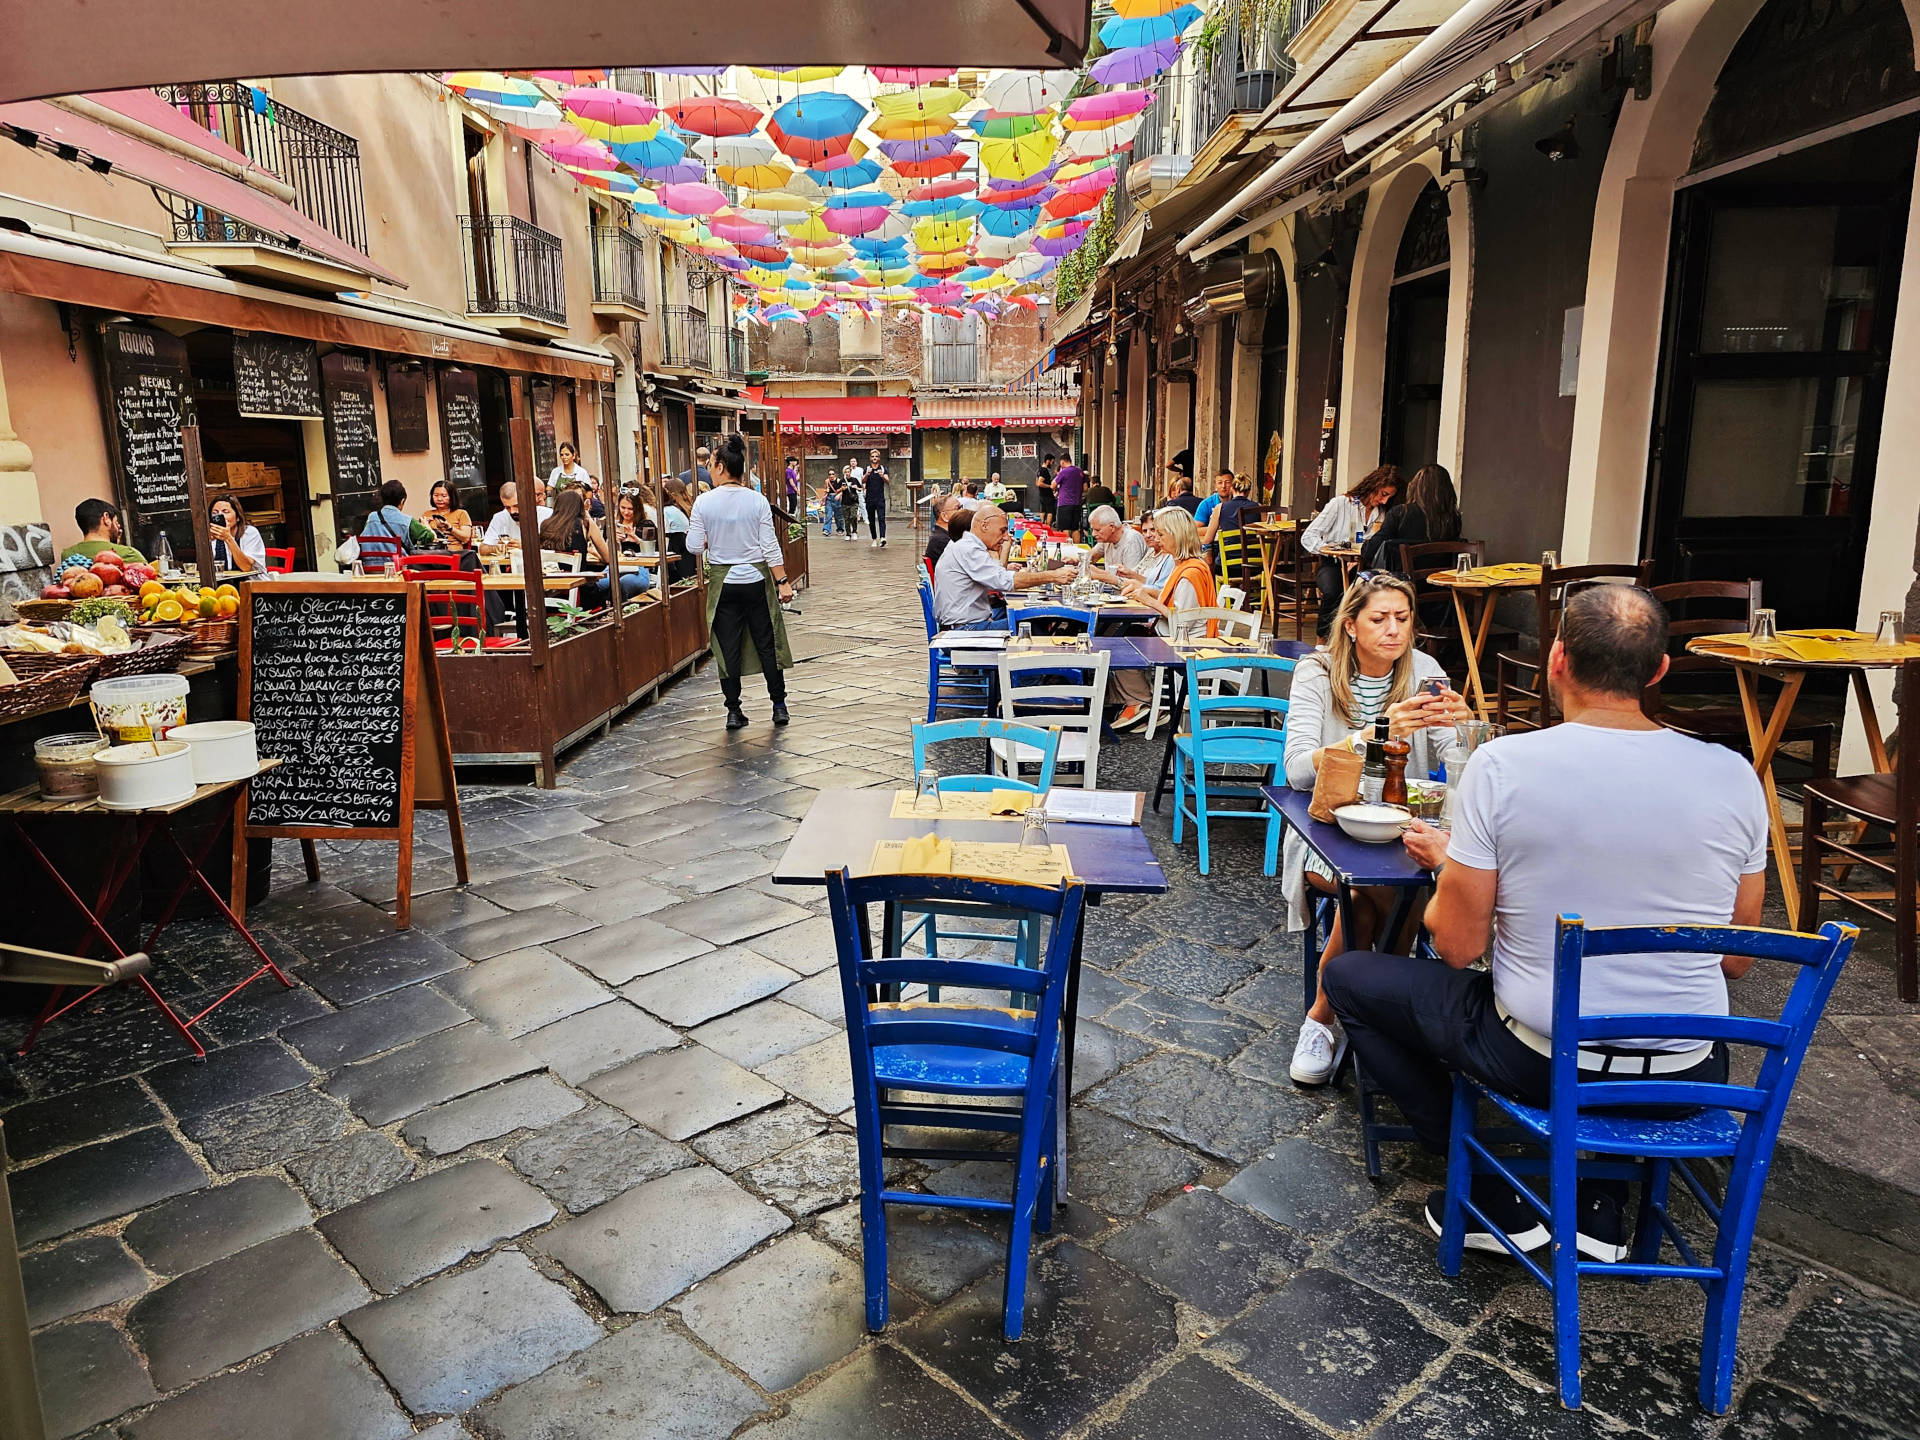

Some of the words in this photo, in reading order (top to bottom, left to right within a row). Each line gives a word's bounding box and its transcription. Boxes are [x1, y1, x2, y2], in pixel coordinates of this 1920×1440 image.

[119, 331, 155, 356] ROOMS
[140, 376, 171, 390] SPECIALS
[852, 424, 906, 432] Bonaccorso
[949, 419, 992, 427] Antica
[1004, 417, 1074, 426] Salumeria
